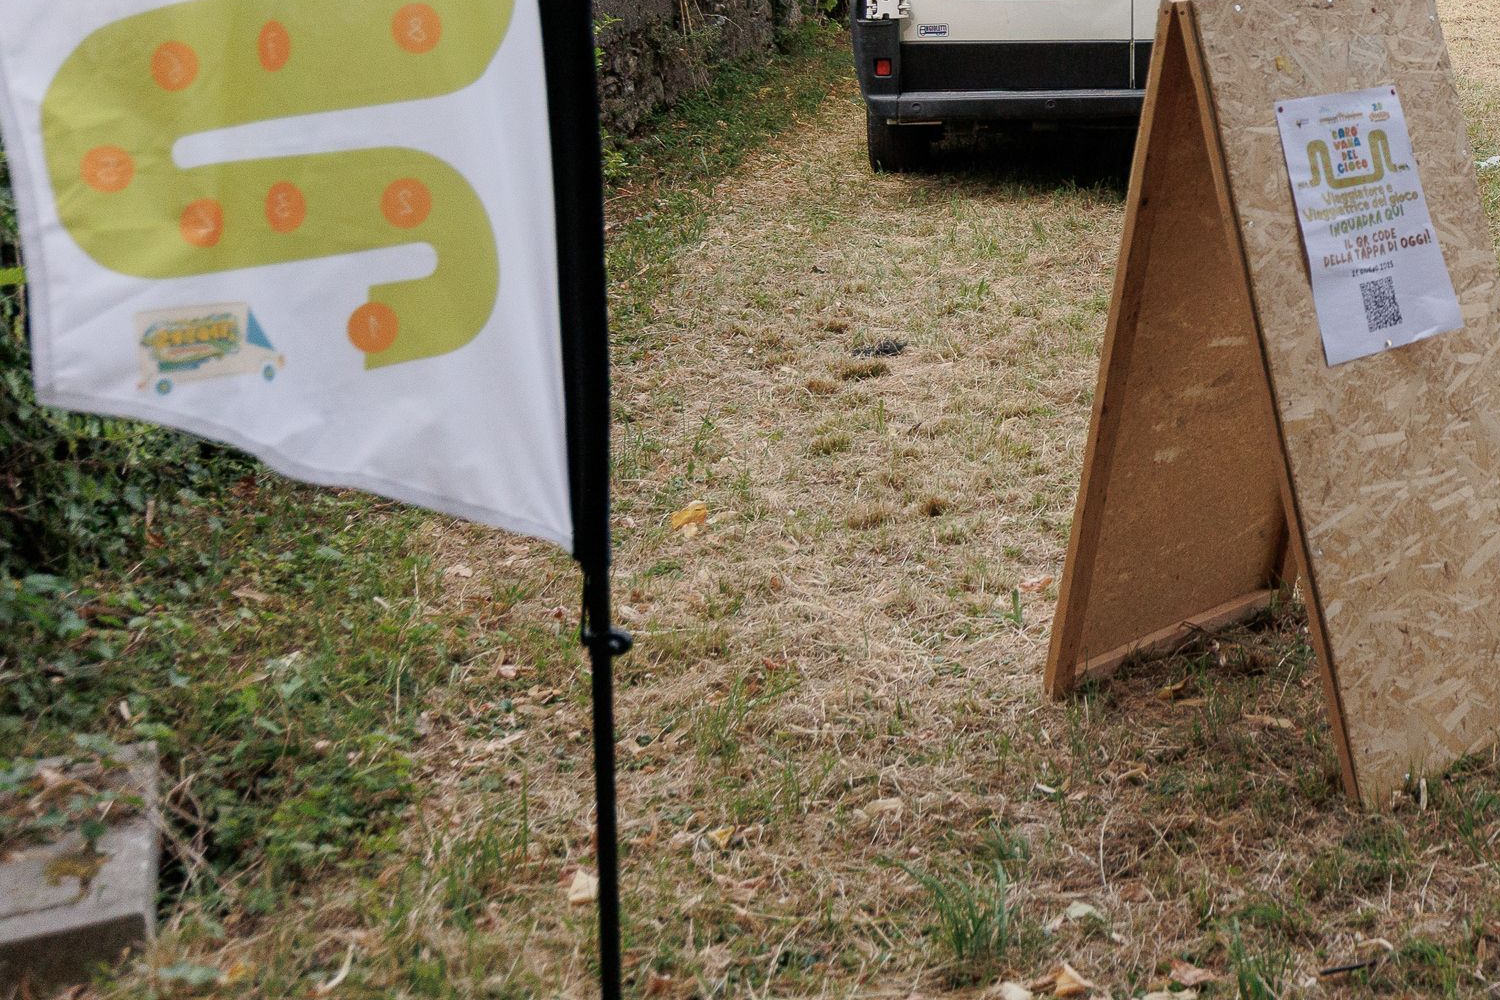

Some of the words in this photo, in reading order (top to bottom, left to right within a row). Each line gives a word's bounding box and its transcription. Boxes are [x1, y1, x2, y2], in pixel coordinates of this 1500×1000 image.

[1341, 149, 1359, 161] DEL
[1389, 190, 1418, 206] gioco
[1329, 209, 1382, 238] INQUADRA
[1385, 204, 1404, 220] QUI
[1323, 251, 1353, 268] DELLA
[1354, 243, 1387, 260] TAPPA
[1387, 240, 1398, 252] DI
[1400, 228, 1432, 248] OGGI!
[1344, 239, 1353, 250] IL
[1356, 235, 1370, 248] QR
[1372, 227, 1397, 242] CODE
